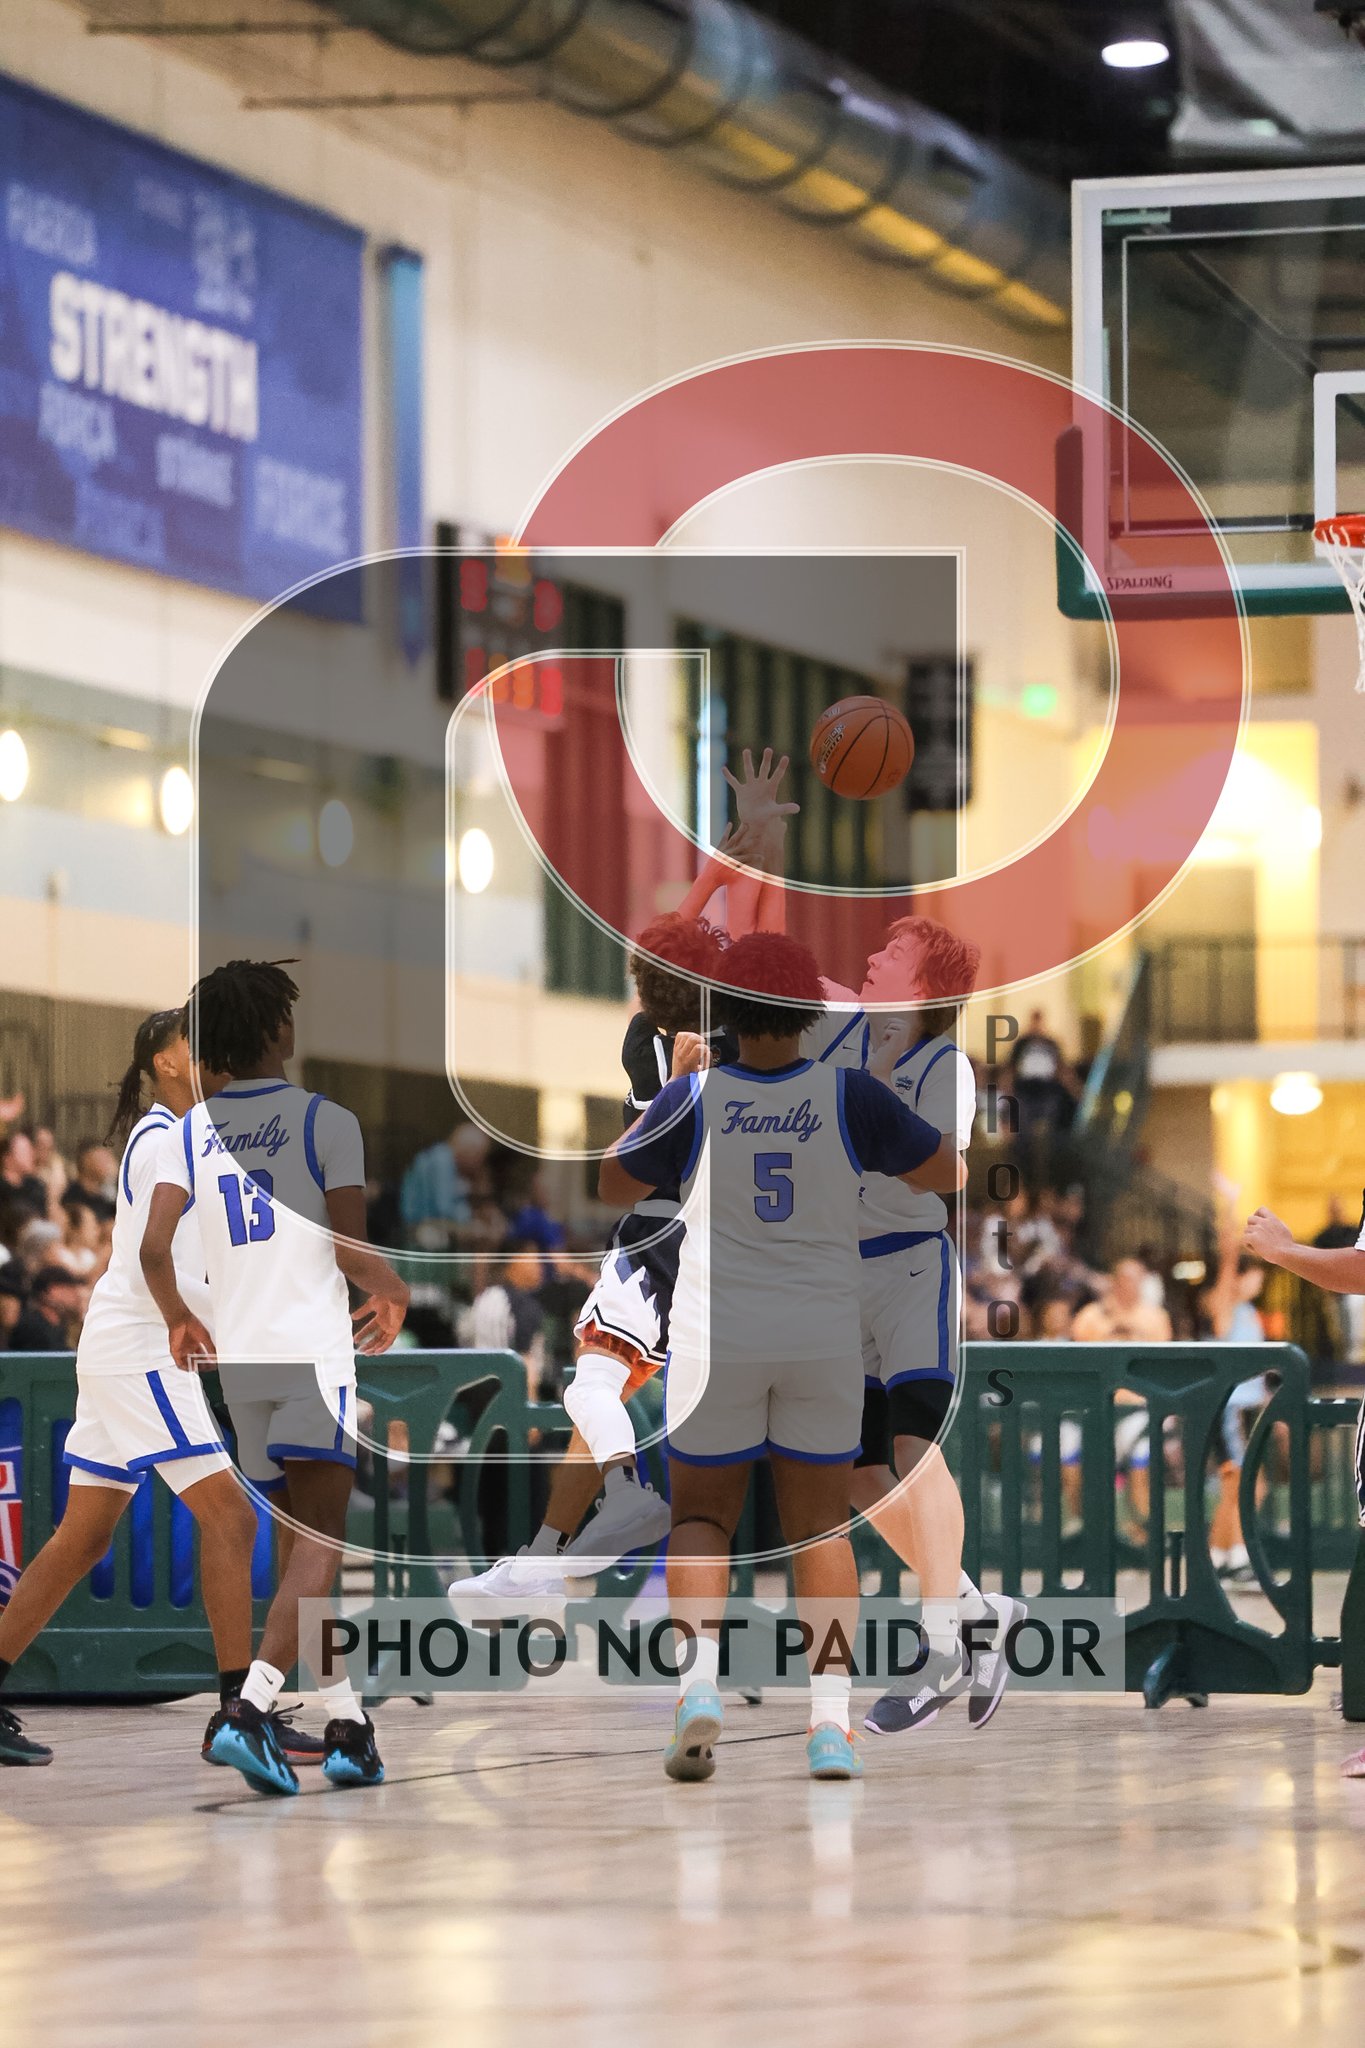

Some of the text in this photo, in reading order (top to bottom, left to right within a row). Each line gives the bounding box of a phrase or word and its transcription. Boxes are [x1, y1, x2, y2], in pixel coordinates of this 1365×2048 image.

[49, 271, 258, 441] STRENGTH
[1107, 575, 1172, 591] SPALDING
[201, 1114, 290, 1157] Family
[721, 1099, 822, 1142] Family
[218, 1169, 275, 1246] 13
[754, 1152, 794, 1223] 5
